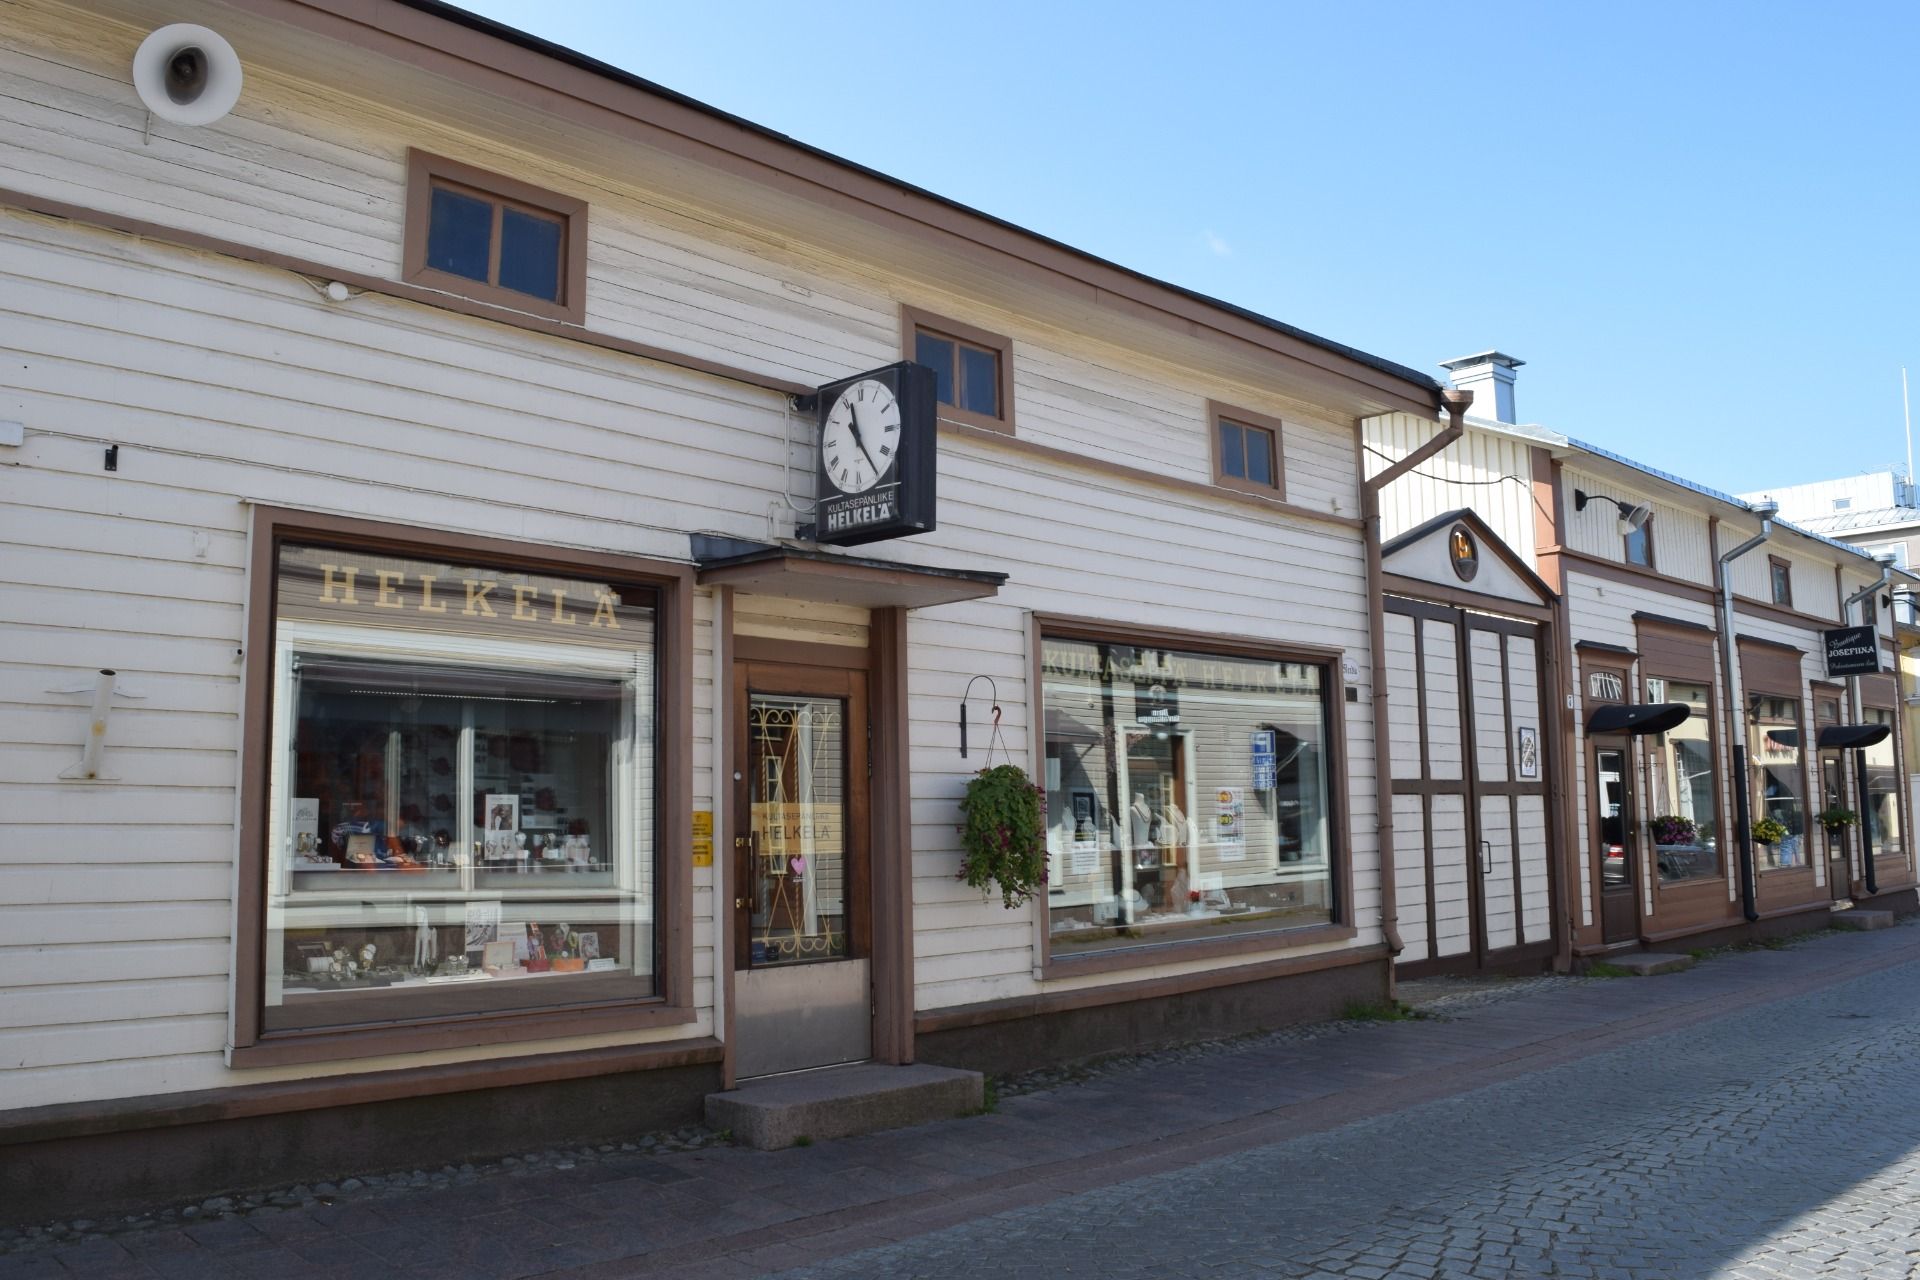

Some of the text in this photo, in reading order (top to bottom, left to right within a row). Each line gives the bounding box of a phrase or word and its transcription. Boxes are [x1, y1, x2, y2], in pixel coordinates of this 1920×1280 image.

[827, 490, 894, 514] KULTASEPÄNLIIKE
[827, 502, 893, 532] HELKELÄ
[318, 562, 622, 630] HELKELÄ
[1828, 646, 1874, 657] JOSEFIINA
[762, 823, 832, 840] HELKELÄ
